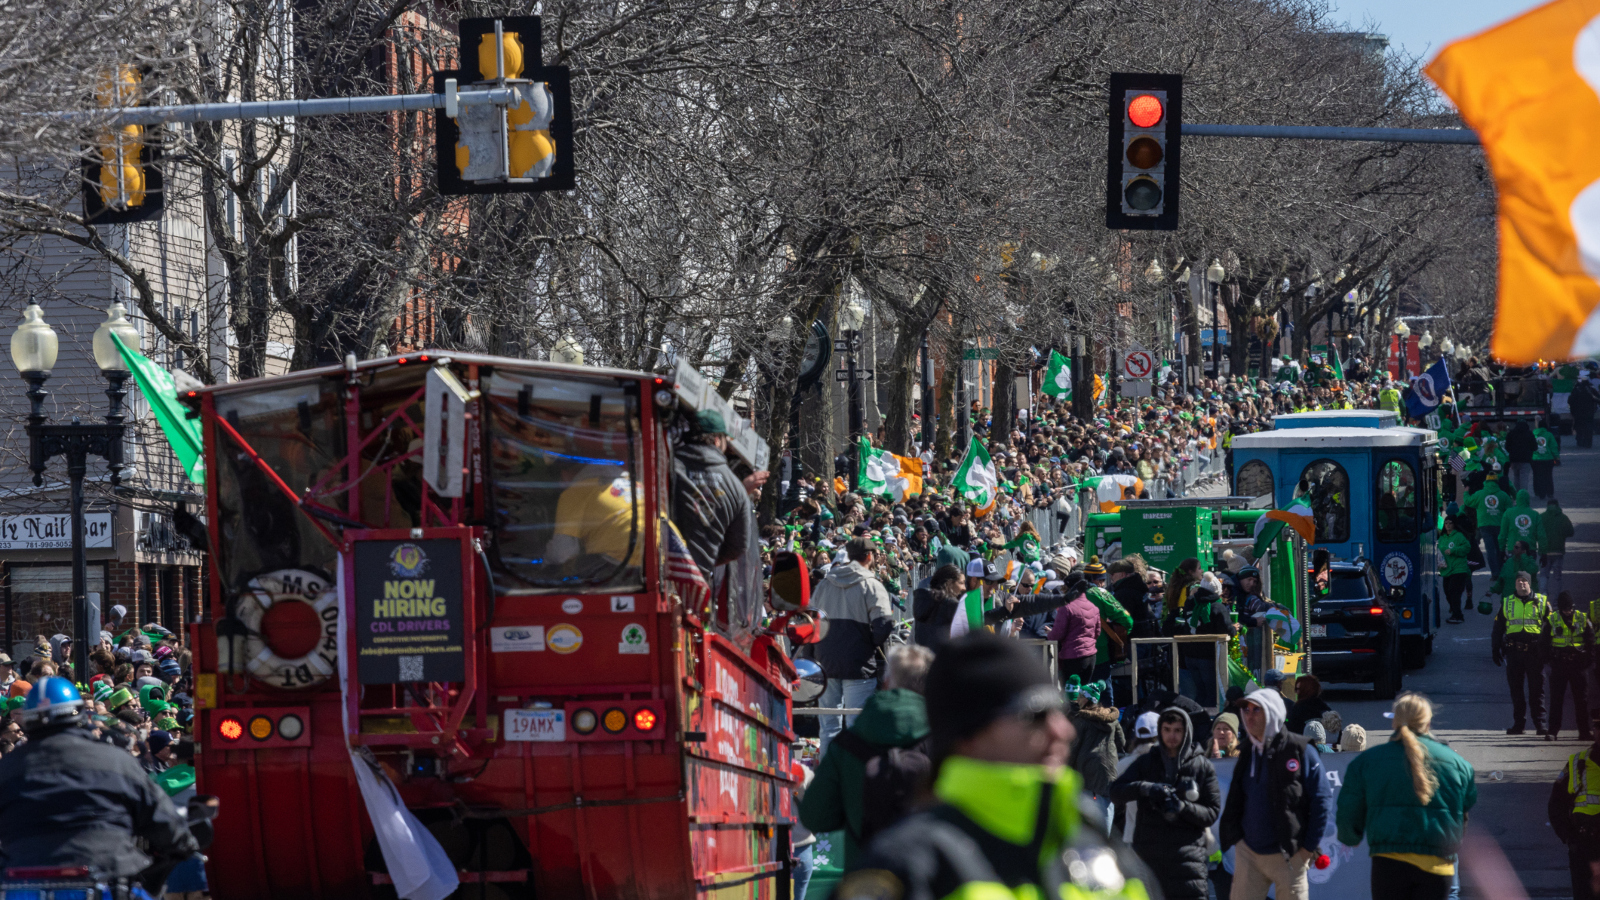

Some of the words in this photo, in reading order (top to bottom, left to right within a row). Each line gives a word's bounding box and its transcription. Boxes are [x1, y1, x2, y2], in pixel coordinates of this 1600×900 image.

[472, 453, 482, 484] HEAD
[2, 518, 19, 540] ly
[23, 517, 66, 540] Nail
[25, 541, 72, 549] 781-990-5052
[282, 574, 321, 601] MS
[384, 579, 435, 599] NOW
[373, 597, 447, 618] HIRING
[370, 621, 395, 633] CDL
[397, 619, 451, 632] DRIVERS
[513, 717, 555, 733] 19AMX
